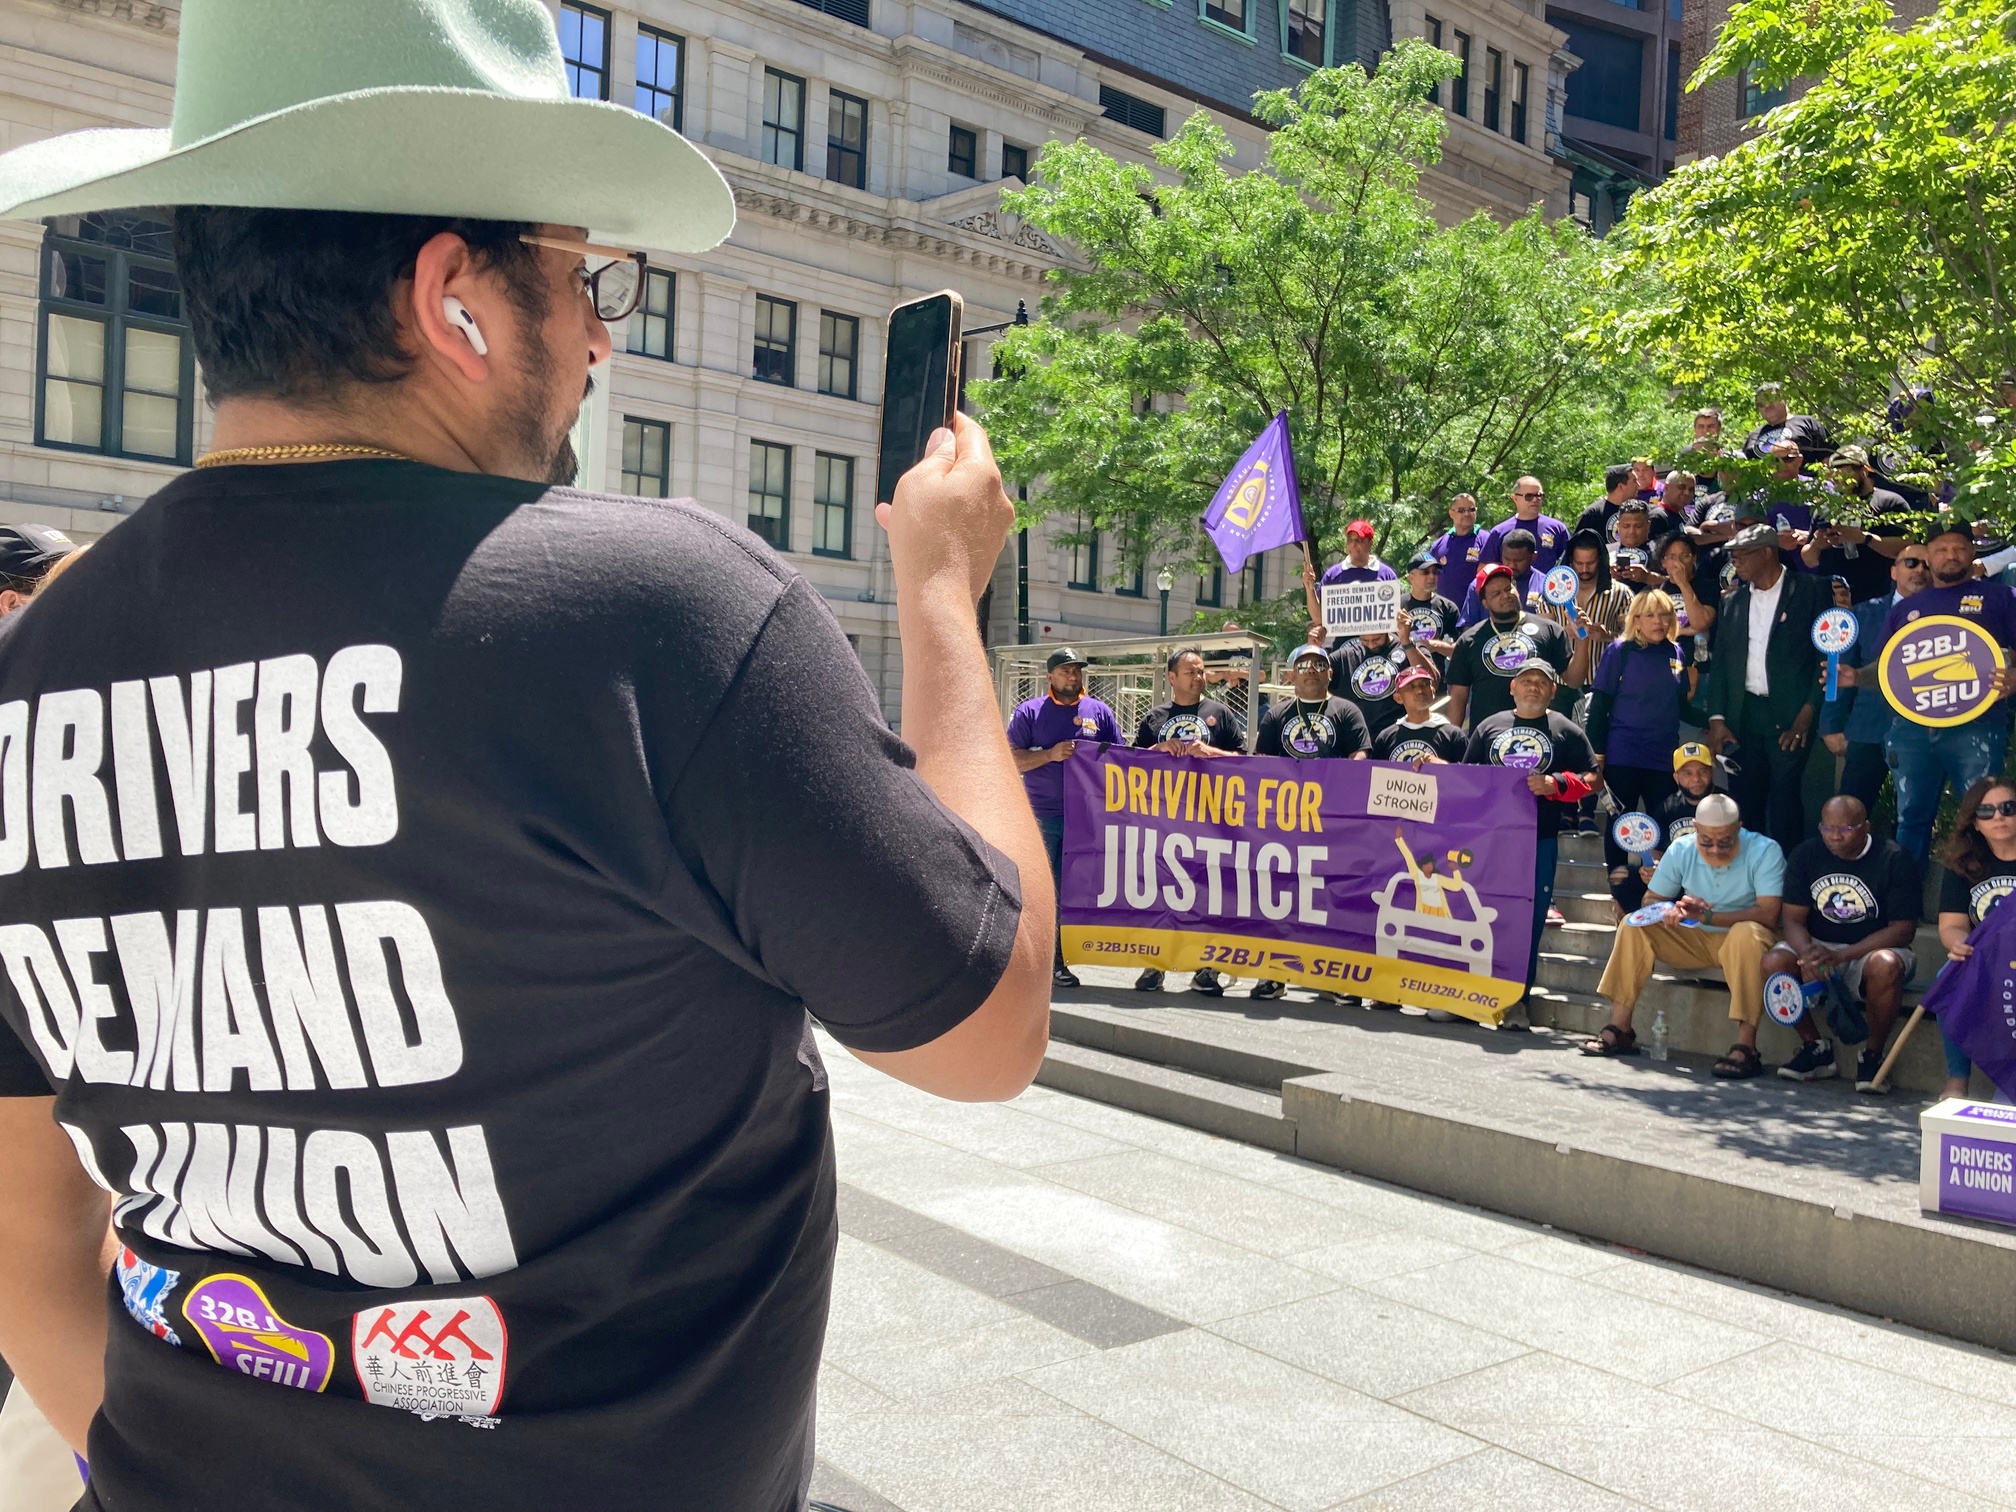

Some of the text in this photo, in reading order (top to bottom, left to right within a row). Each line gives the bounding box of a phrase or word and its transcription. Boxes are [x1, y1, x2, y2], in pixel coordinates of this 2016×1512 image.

[1327, 588, 1350, 596] DRIVERS
[1352, 586, 1375, 594] DEMAND
[1327, 594, 1375, 606] FREEDOM TO
[1327, 603, 1395, 624] UNIONIZE
[1901, 630, 1967, 664] 32BJ
[1915, 679, 1980, 711] SEIU
[1105, 763, 1323, 833] DRIVING FOR
[1386, 779, 1427, 796] UNION
[1373, 794, 1433, 814] STRONG!
[1097, 825, 1328, 926] JUSTICE
[1200, 945, 1265, 967] 32BJ
[1310, 959, 1373, 982] SEIU
[1400, 977, 1499, 1008] SEIU32BJ.ORG
[0, 901, 464, 1092] DEMAND
[1949, 1145, 2013, 1172] DRIVERS
[1949, 1166, 2012, 1194] A UNION
[200, 1295, 279, 1332] 32BJ
[365, 1355, 488, 1389] 華人前進會
[373, 1382, 487, 1401] CHINESE PROGRESSIVE
[392, 1397, 463, 1412] ASSOCIATION
